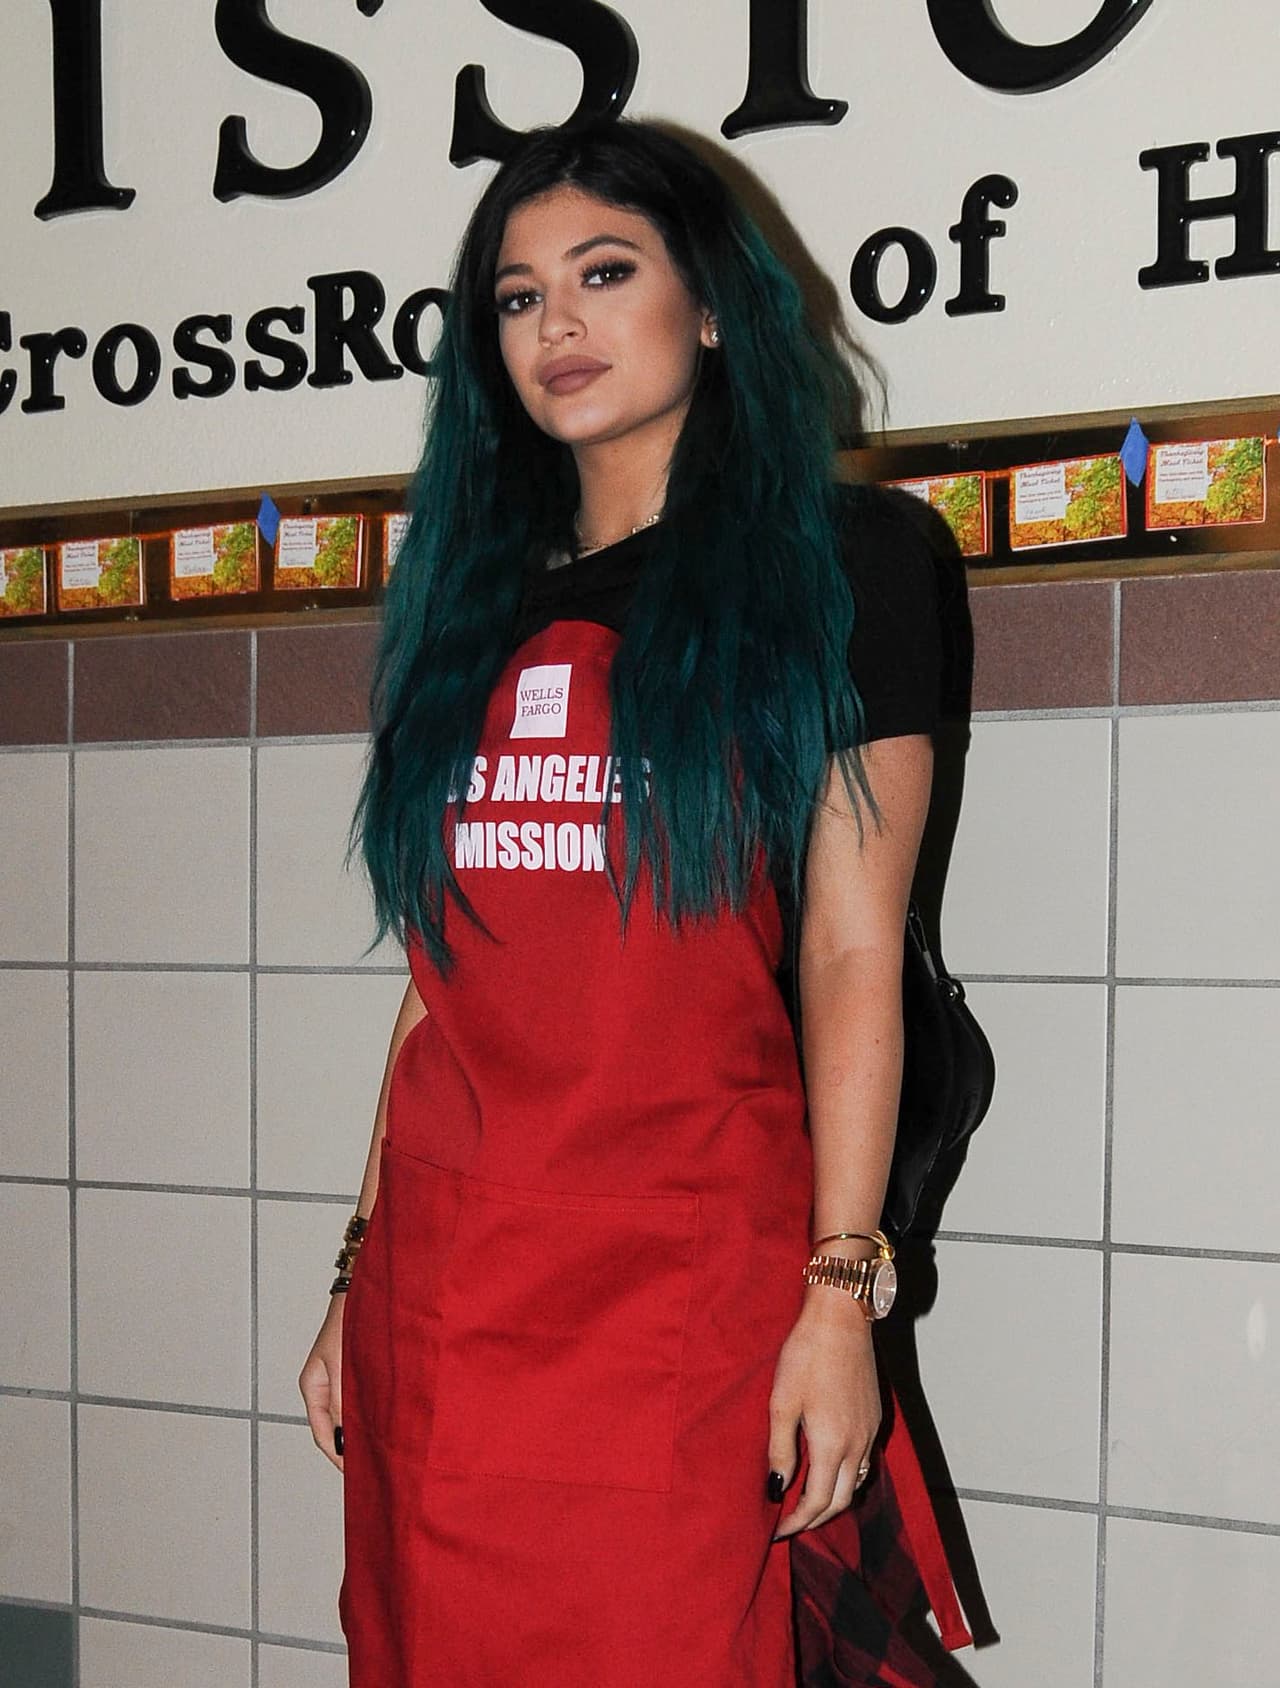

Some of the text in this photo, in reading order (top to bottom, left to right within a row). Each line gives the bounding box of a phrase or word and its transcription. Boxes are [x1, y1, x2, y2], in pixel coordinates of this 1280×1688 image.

[0, 270, 455, 414] rossRo
[850, 174, 1018, 325] of
[520, 687, 564, 701] WELLS
[521, 702, 562, 717] FARGO
[455, 821, 606, 872] MISSION
